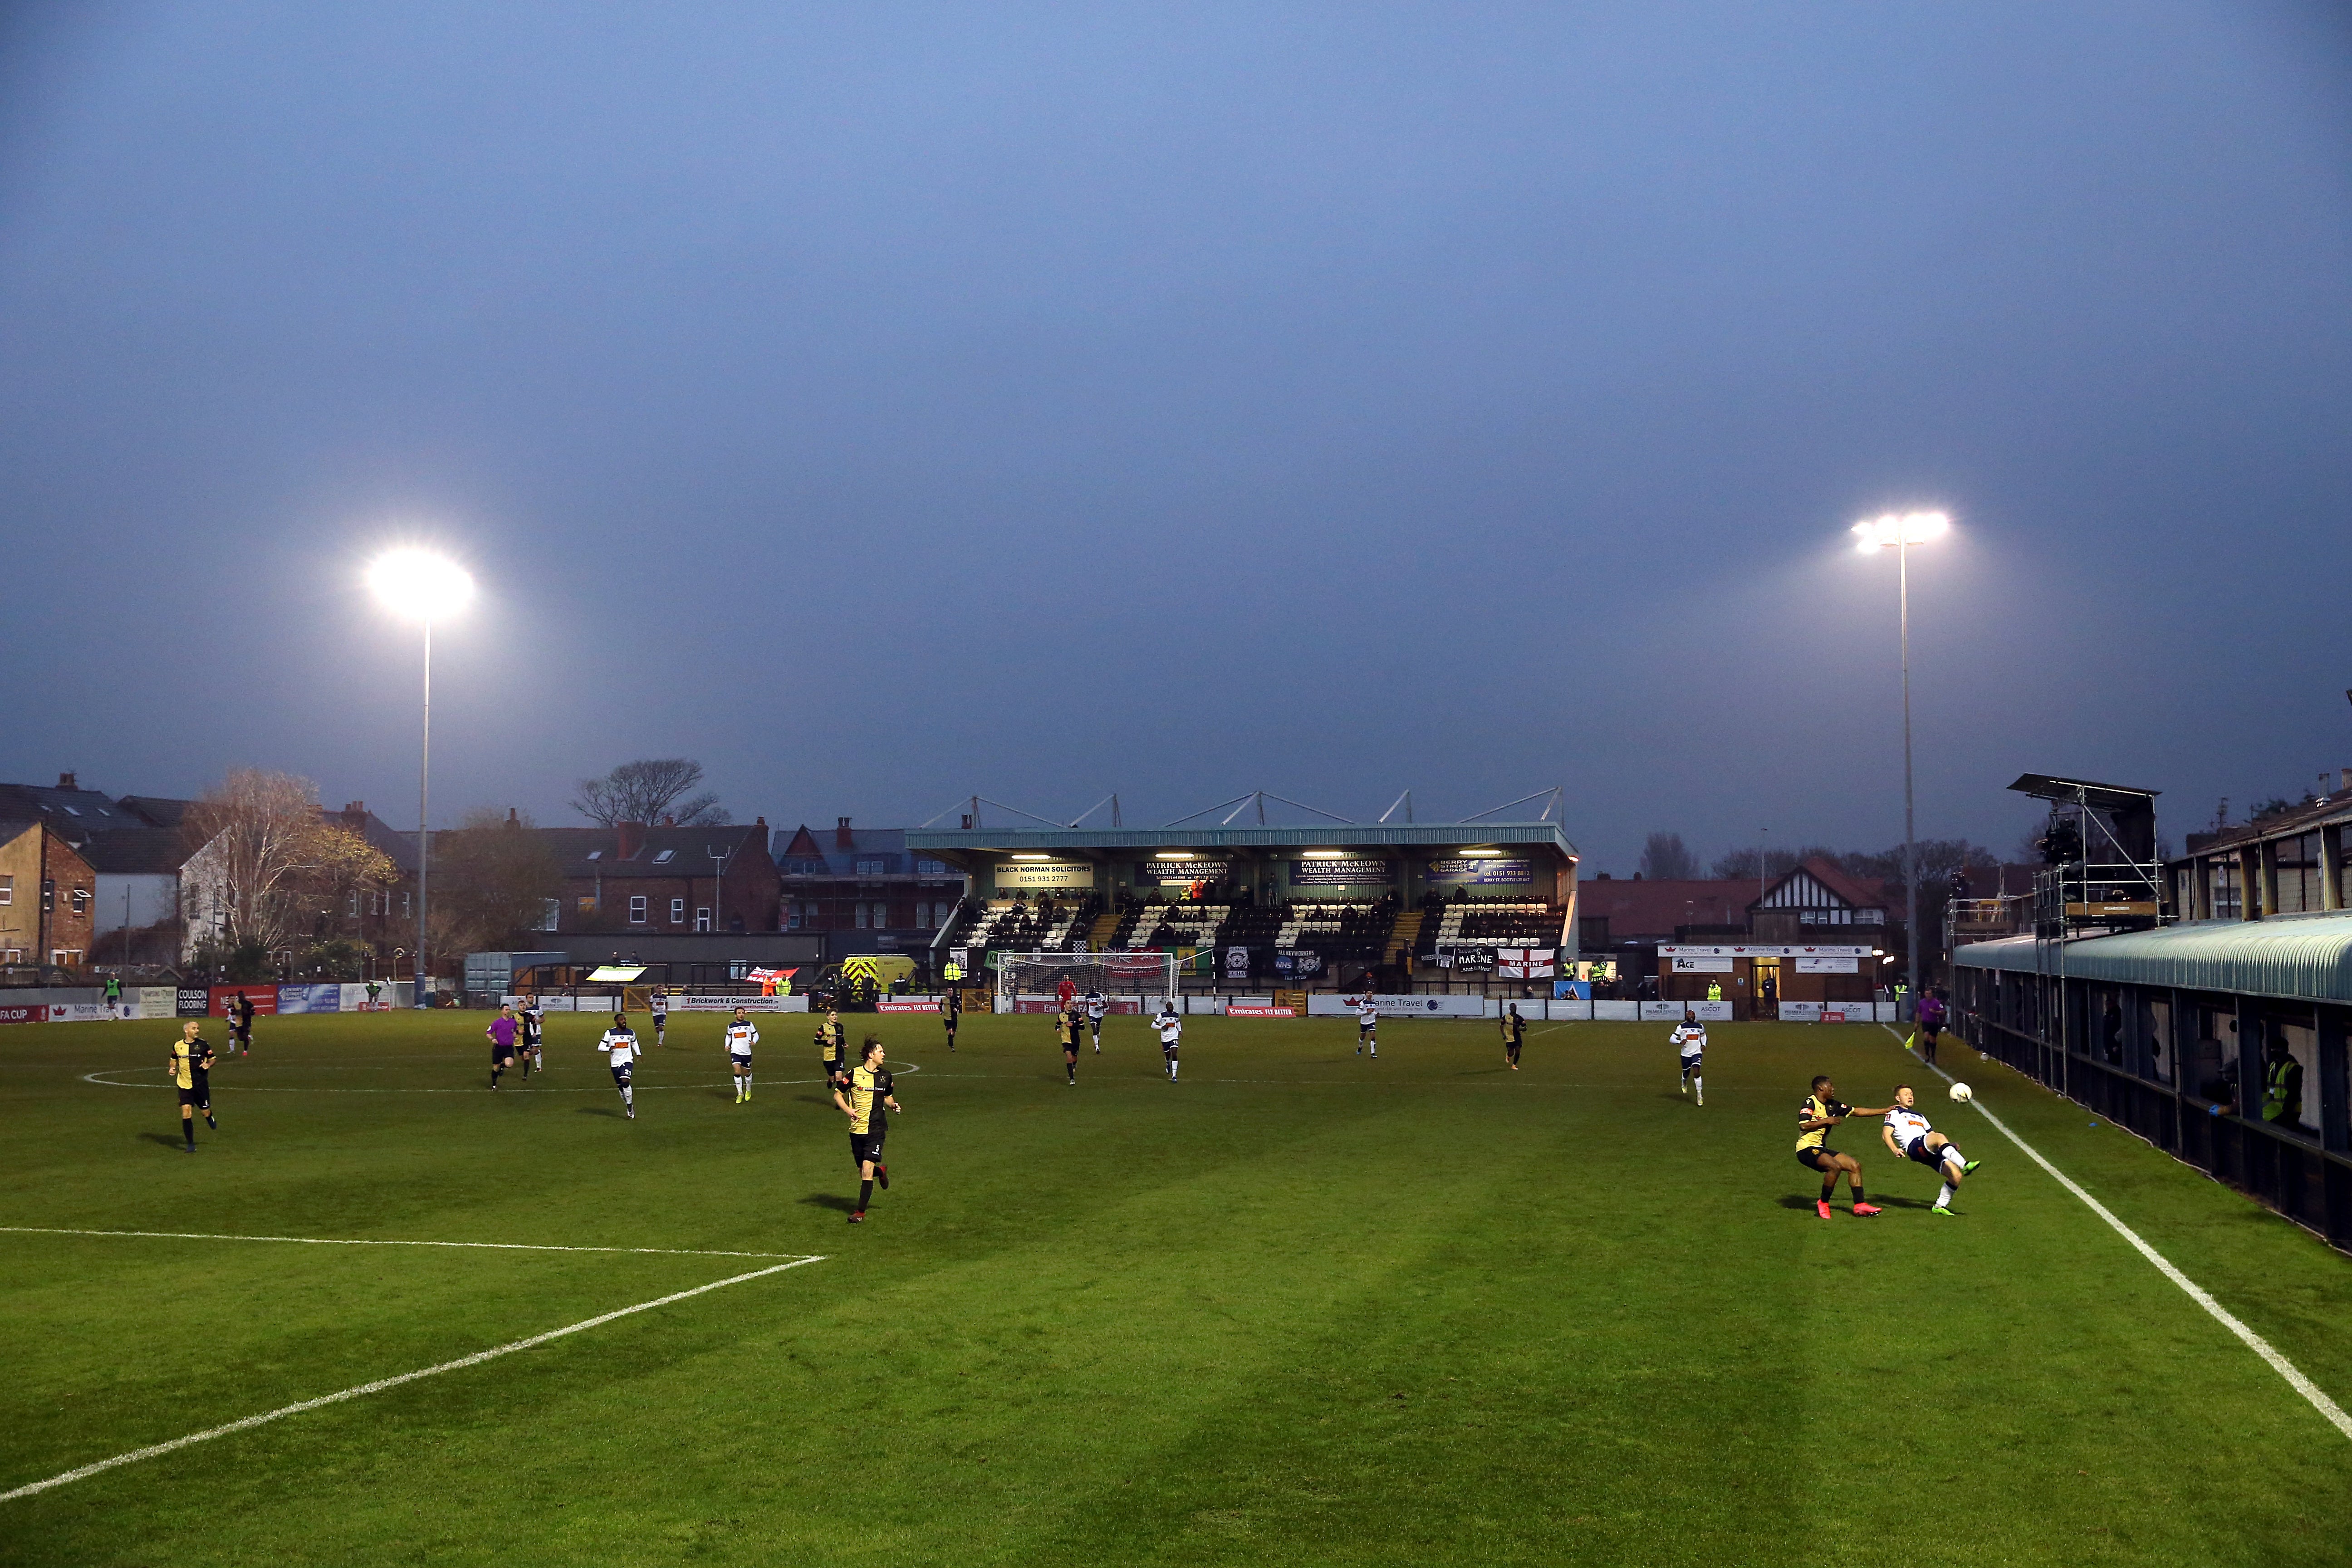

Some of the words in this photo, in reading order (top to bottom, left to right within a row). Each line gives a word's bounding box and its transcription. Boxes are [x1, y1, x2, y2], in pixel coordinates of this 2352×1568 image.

[1677, 958, 1694, 968] ACE
[179, 990, 207, 999] COULSON
[74, 1004, 97, 1014] Marine
[100, 1004, 118, 1013] Tral
[179, 1000, 206, 1009] FLOORING
[0, 1010, 9, 1019] FA
[11, 1009, 27, 1019] CUP
